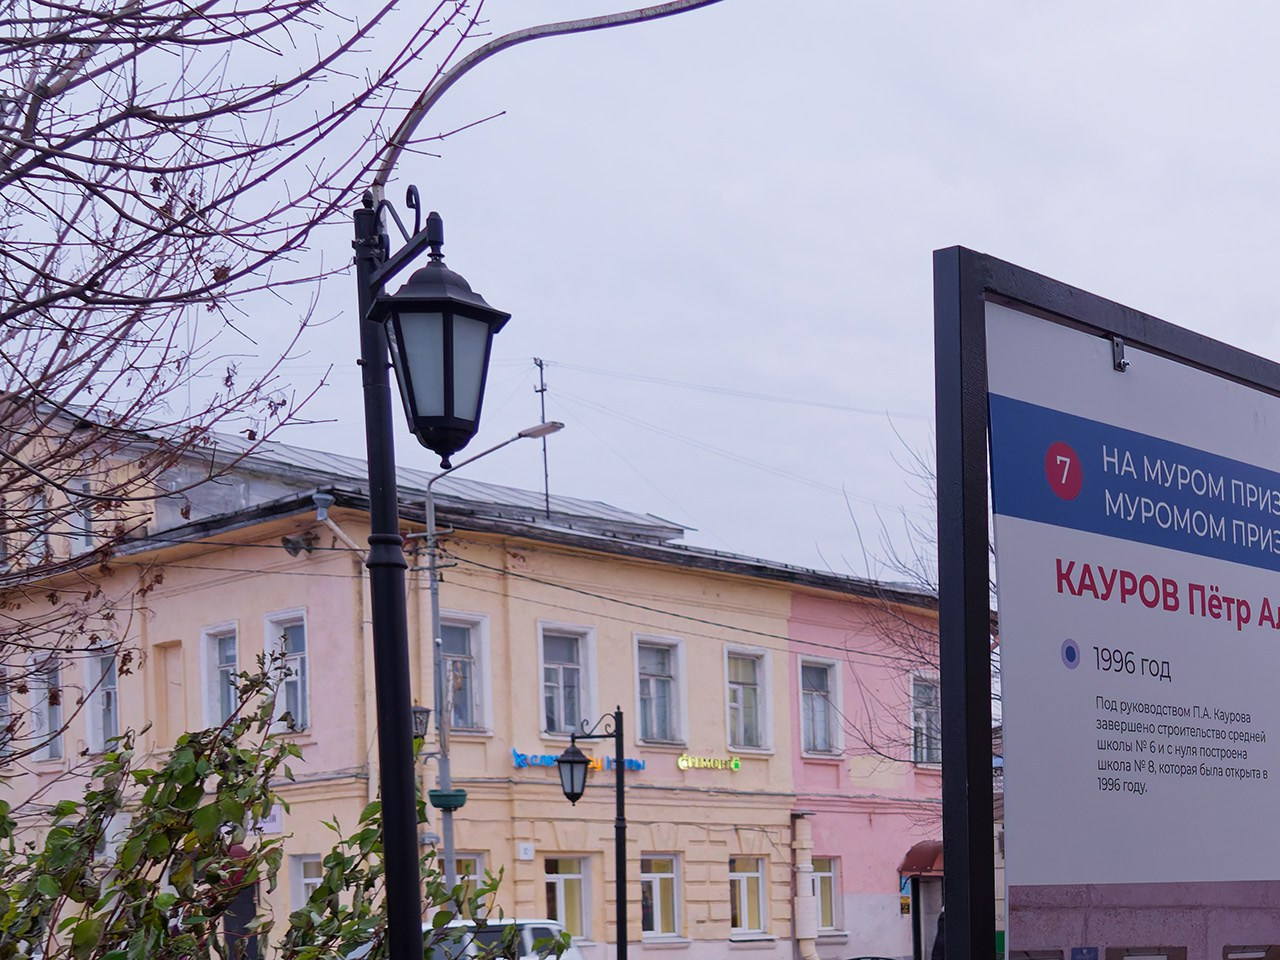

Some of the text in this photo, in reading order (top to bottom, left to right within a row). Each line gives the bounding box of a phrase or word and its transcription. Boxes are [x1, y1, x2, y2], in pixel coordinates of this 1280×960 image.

[1056, 455, 1071, 484] 7
[1102, 445, 1137, 479] НА
[1143, 455, 1225, 501] МУРОМ
[1105, 489, 1226, 541] МУРОМОМ
[1055, 558, 1180, 612] КАУРОВ
[1188, 582, 1251, 631] Пётр
[1093, 646, 1172, 683] 1996 год
[1095, 696, 1251, 724] Под руководством П.А. Каурова
[1096, 719, 1266, 743] завершено строительство средней
[1096, 739, 1248, 760] школы № 6 и с нуля построена
[1097, 759, 1268, 780] школа № 8, которая была открыта в
[1097, 777, 1148, 795] 1996 году.
